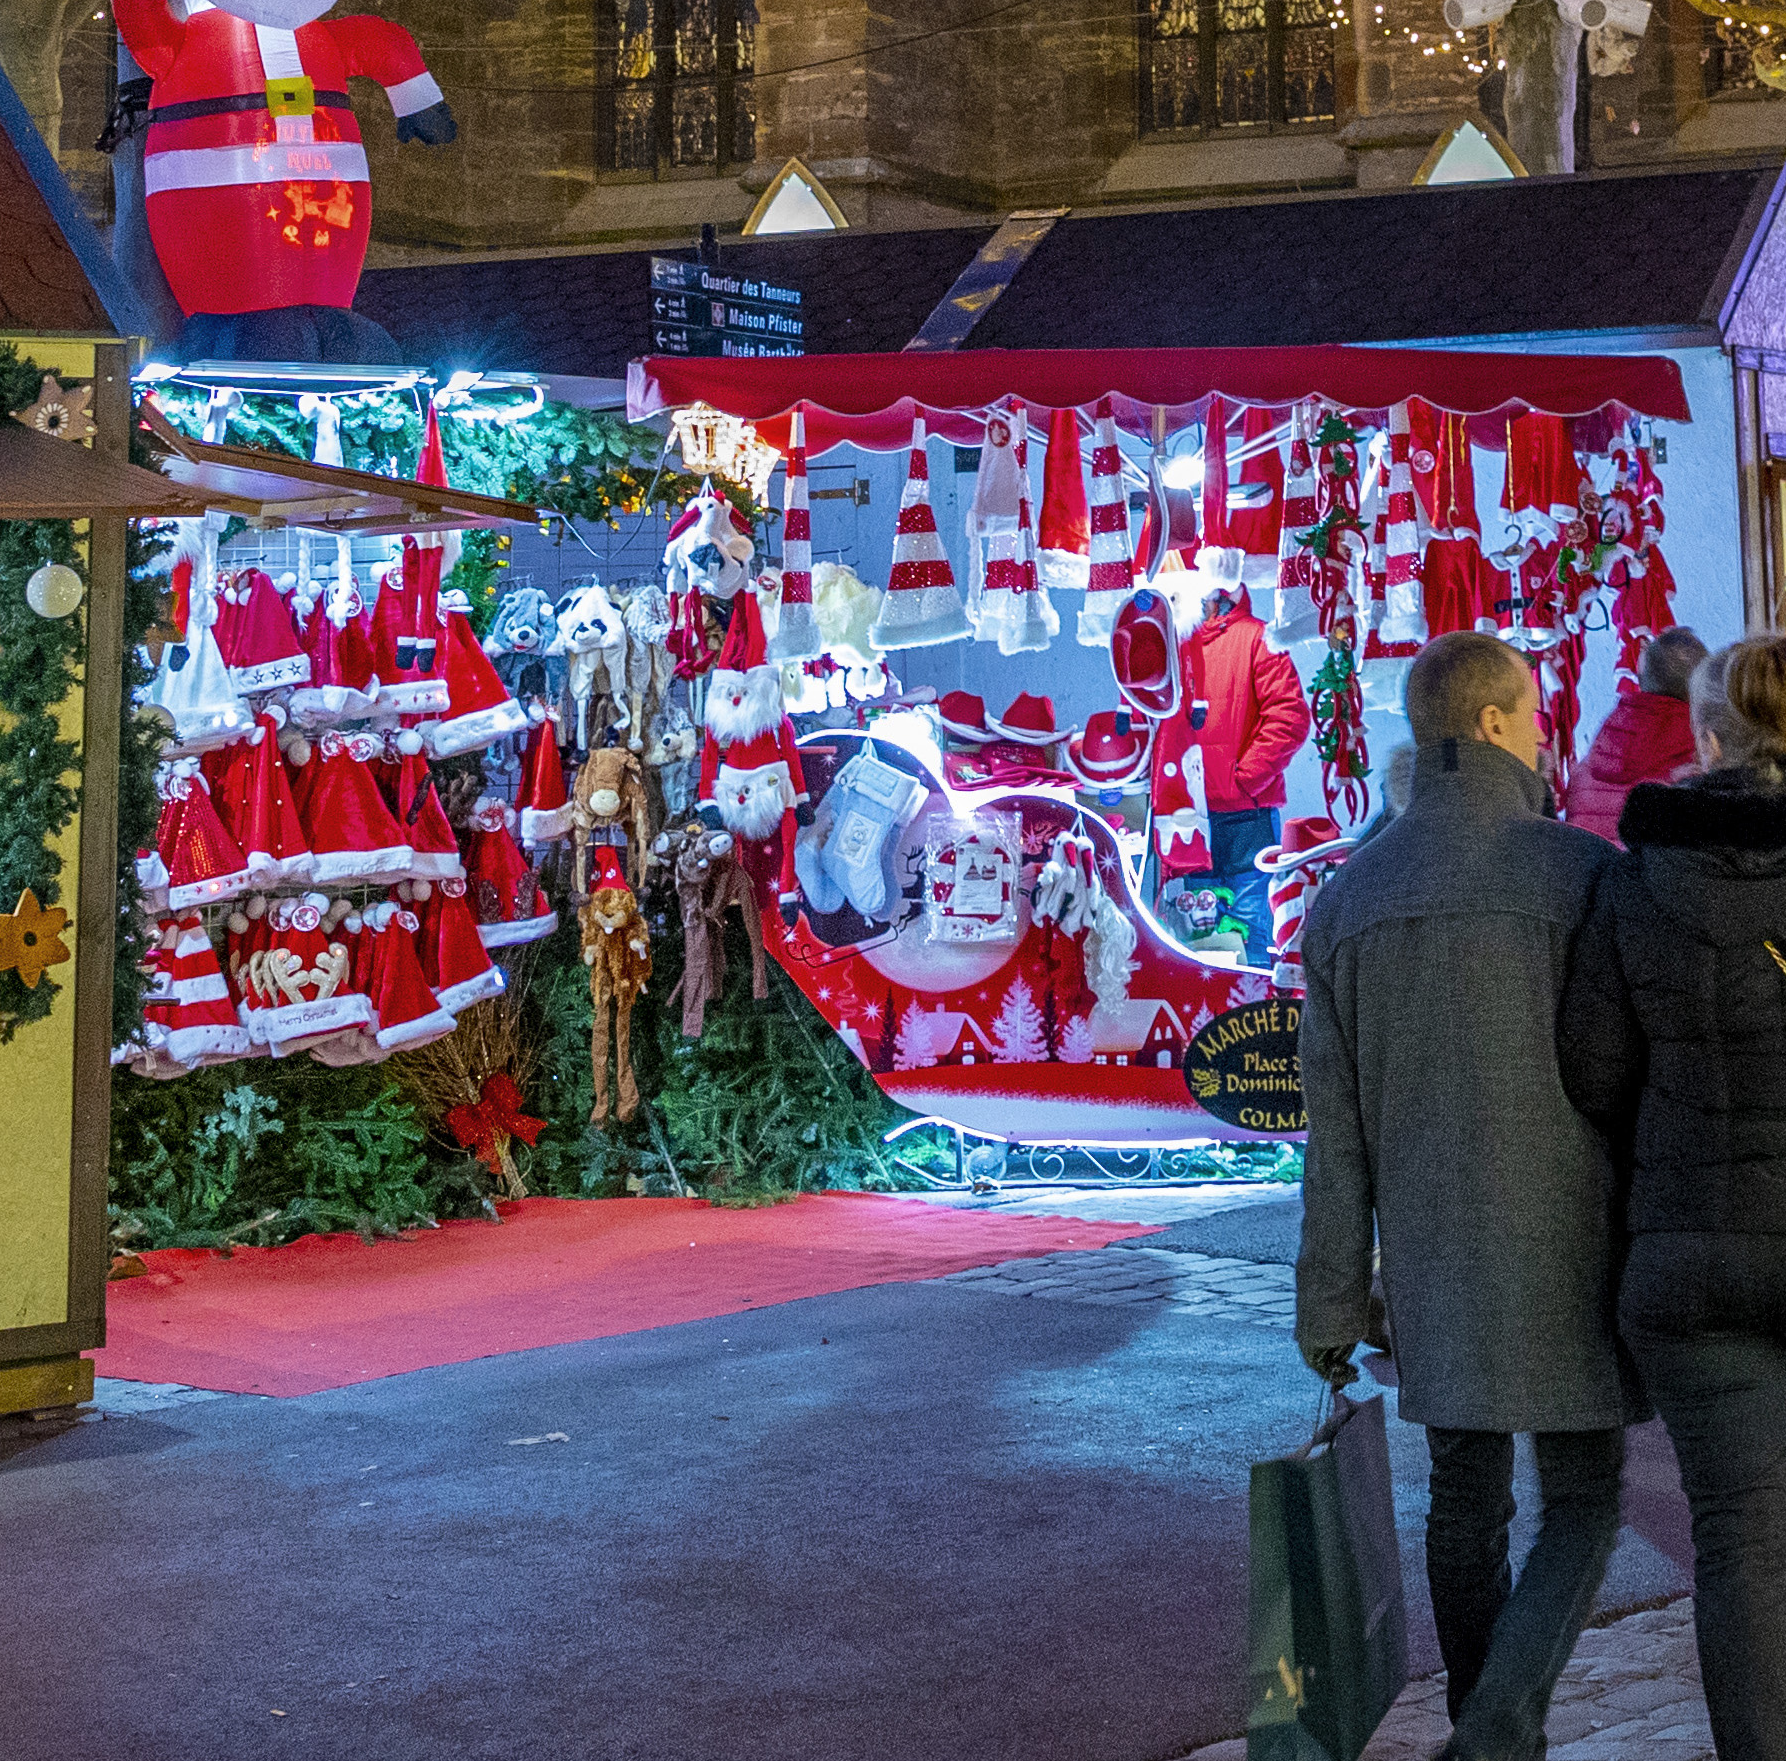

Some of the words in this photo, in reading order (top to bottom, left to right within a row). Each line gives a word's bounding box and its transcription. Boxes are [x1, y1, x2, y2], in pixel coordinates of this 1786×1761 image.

[701, 271, 741, 294] Quartier
[742, 278, 759, 297] des
[760, 281, 802, 305] Tanneurs
[728, 308, 765, 329] Maison
[768, 313, 803, 335] Pfister
[722, 339, 755, 357] Musée
[758, 342, 805, 357] Barthld
[1196, 1001, 1281, 1061] MARCHÉ
[1243, 1052, 1288, 1073] Place
[1226, 1072, 1303, 1092] Dominic
[1238, 1107, 1309, 1130] COLMA
